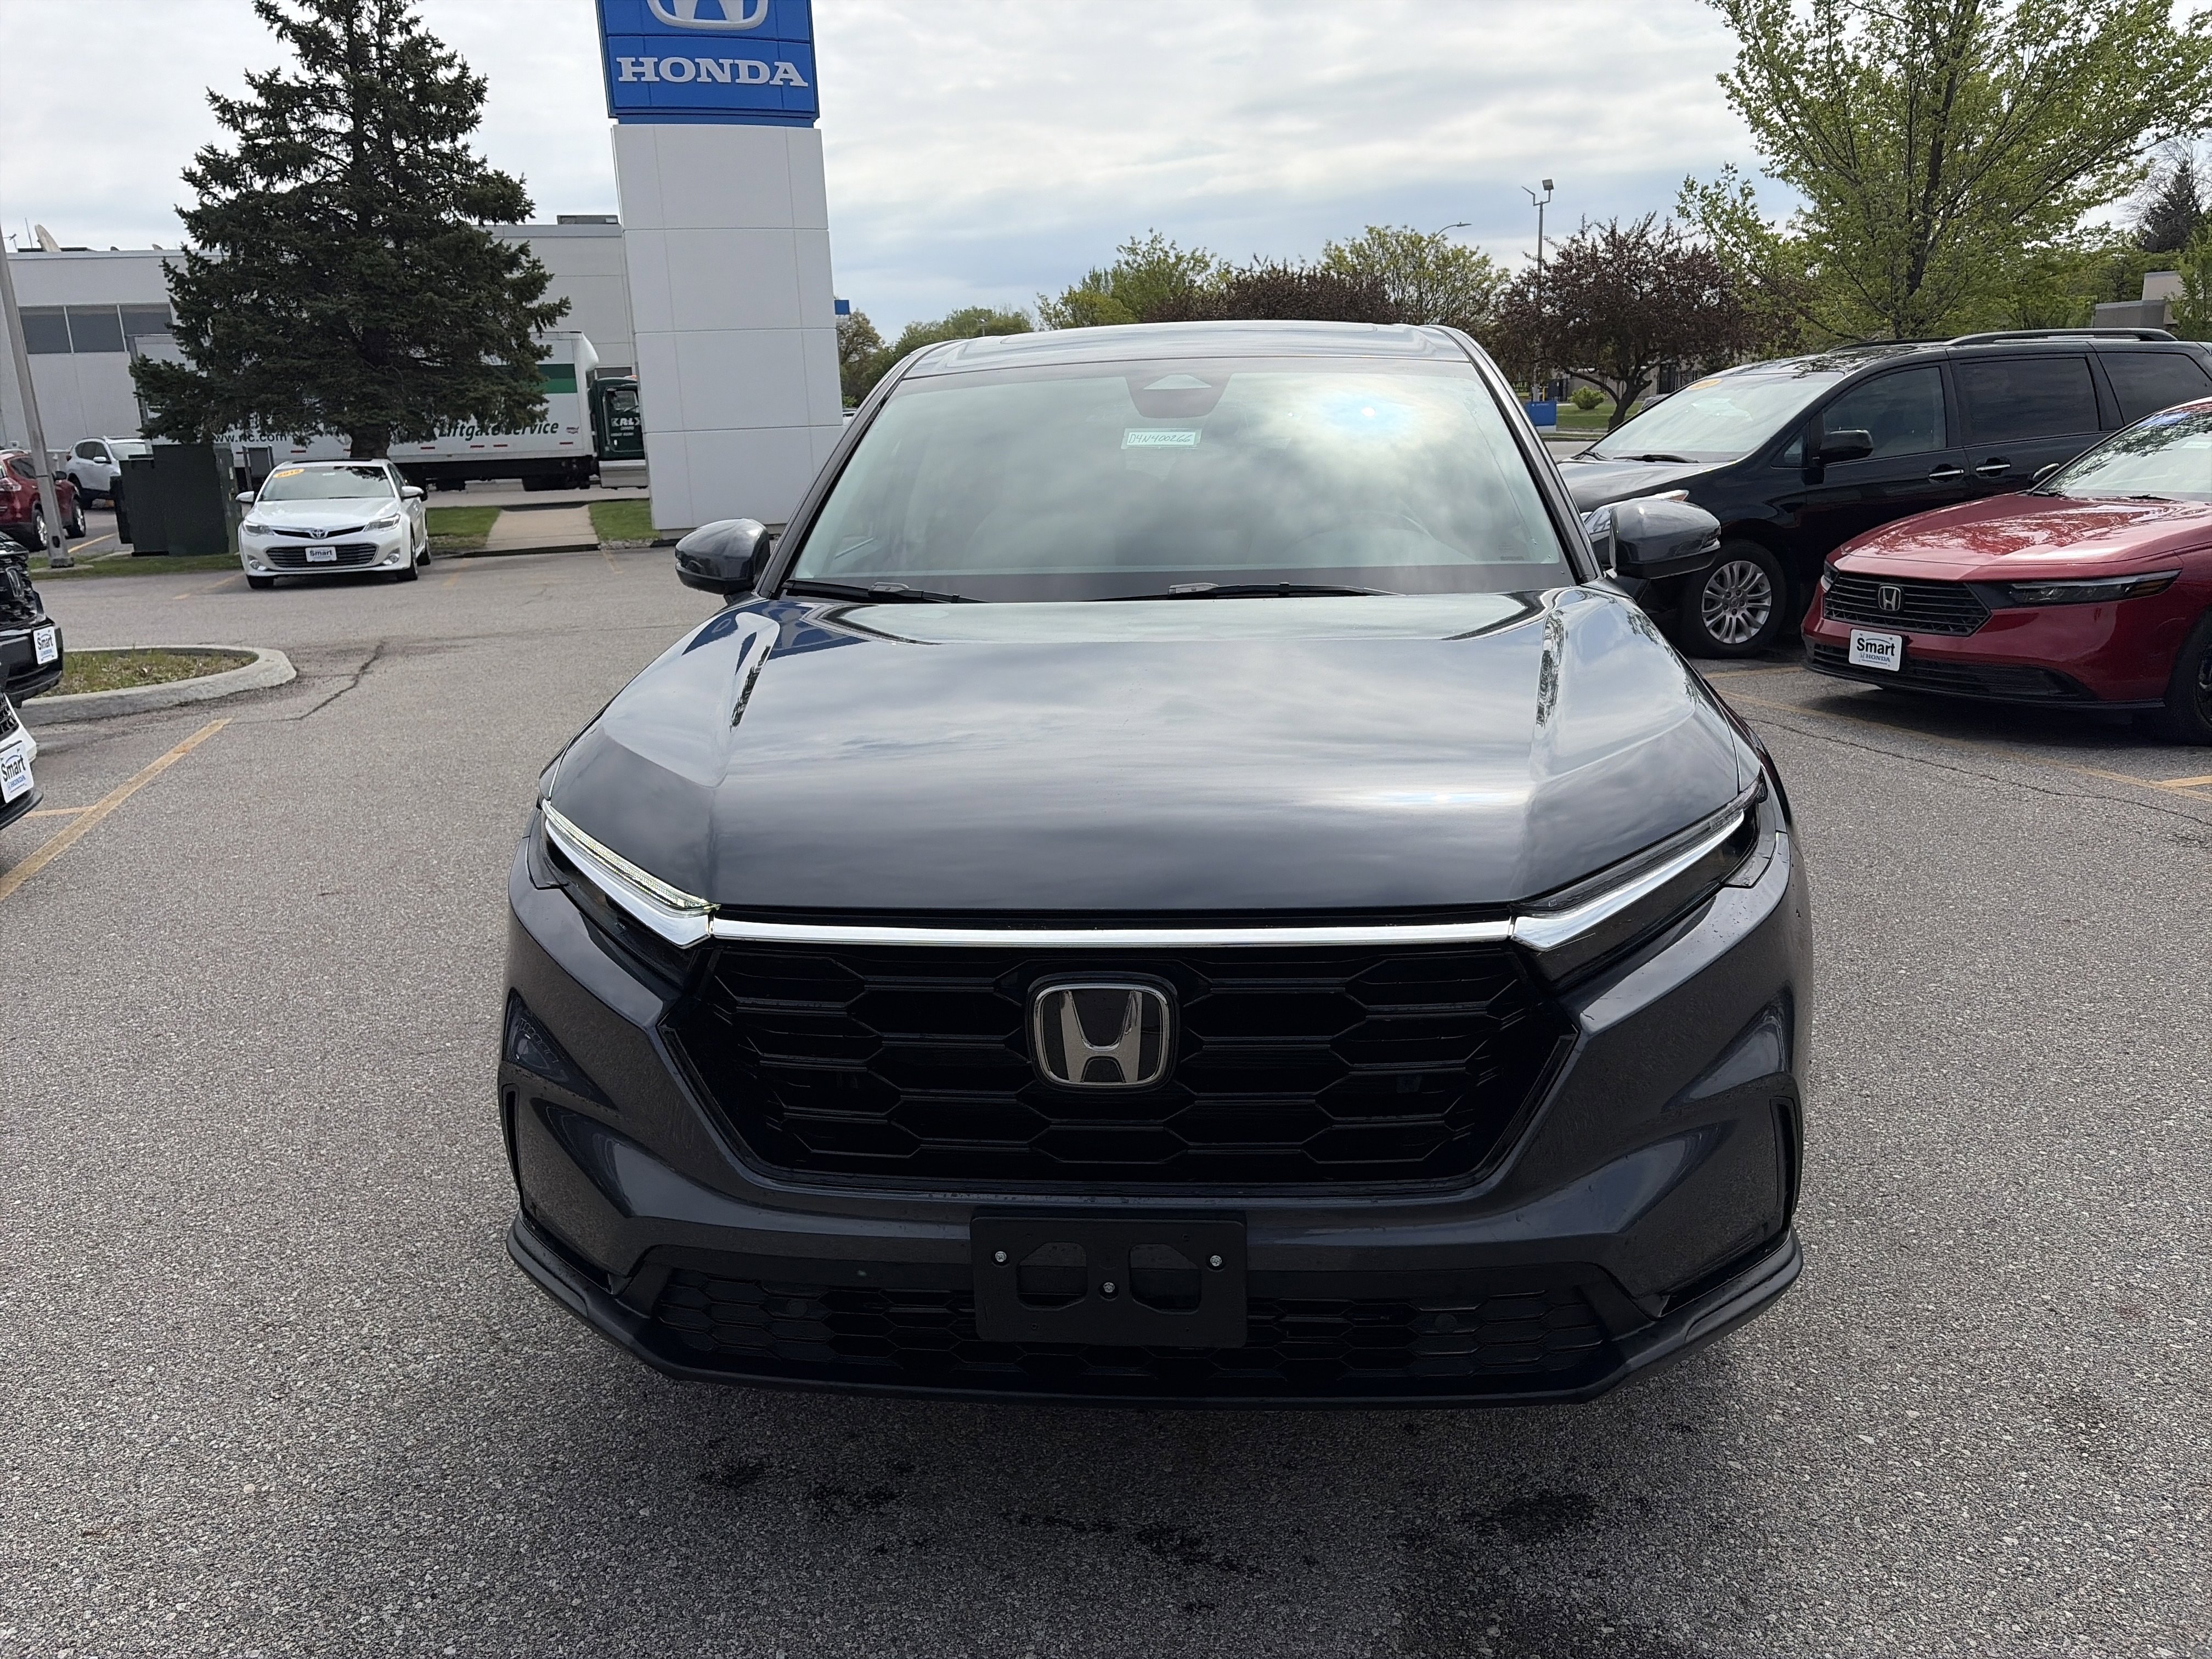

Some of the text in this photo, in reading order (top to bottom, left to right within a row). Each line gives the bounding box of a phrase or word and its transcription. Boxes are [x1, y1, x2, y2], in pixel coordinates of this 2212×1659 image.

[616, 57, 808, 87] HONDA
[37, 635, 53, 650] Smart
[1857, 637, 1895, 656] Smart
[1866, 654, 1891, 662] HONDA
[1, 754, 26, 782] Smart
[11, 775, 26, 788] HONDA
